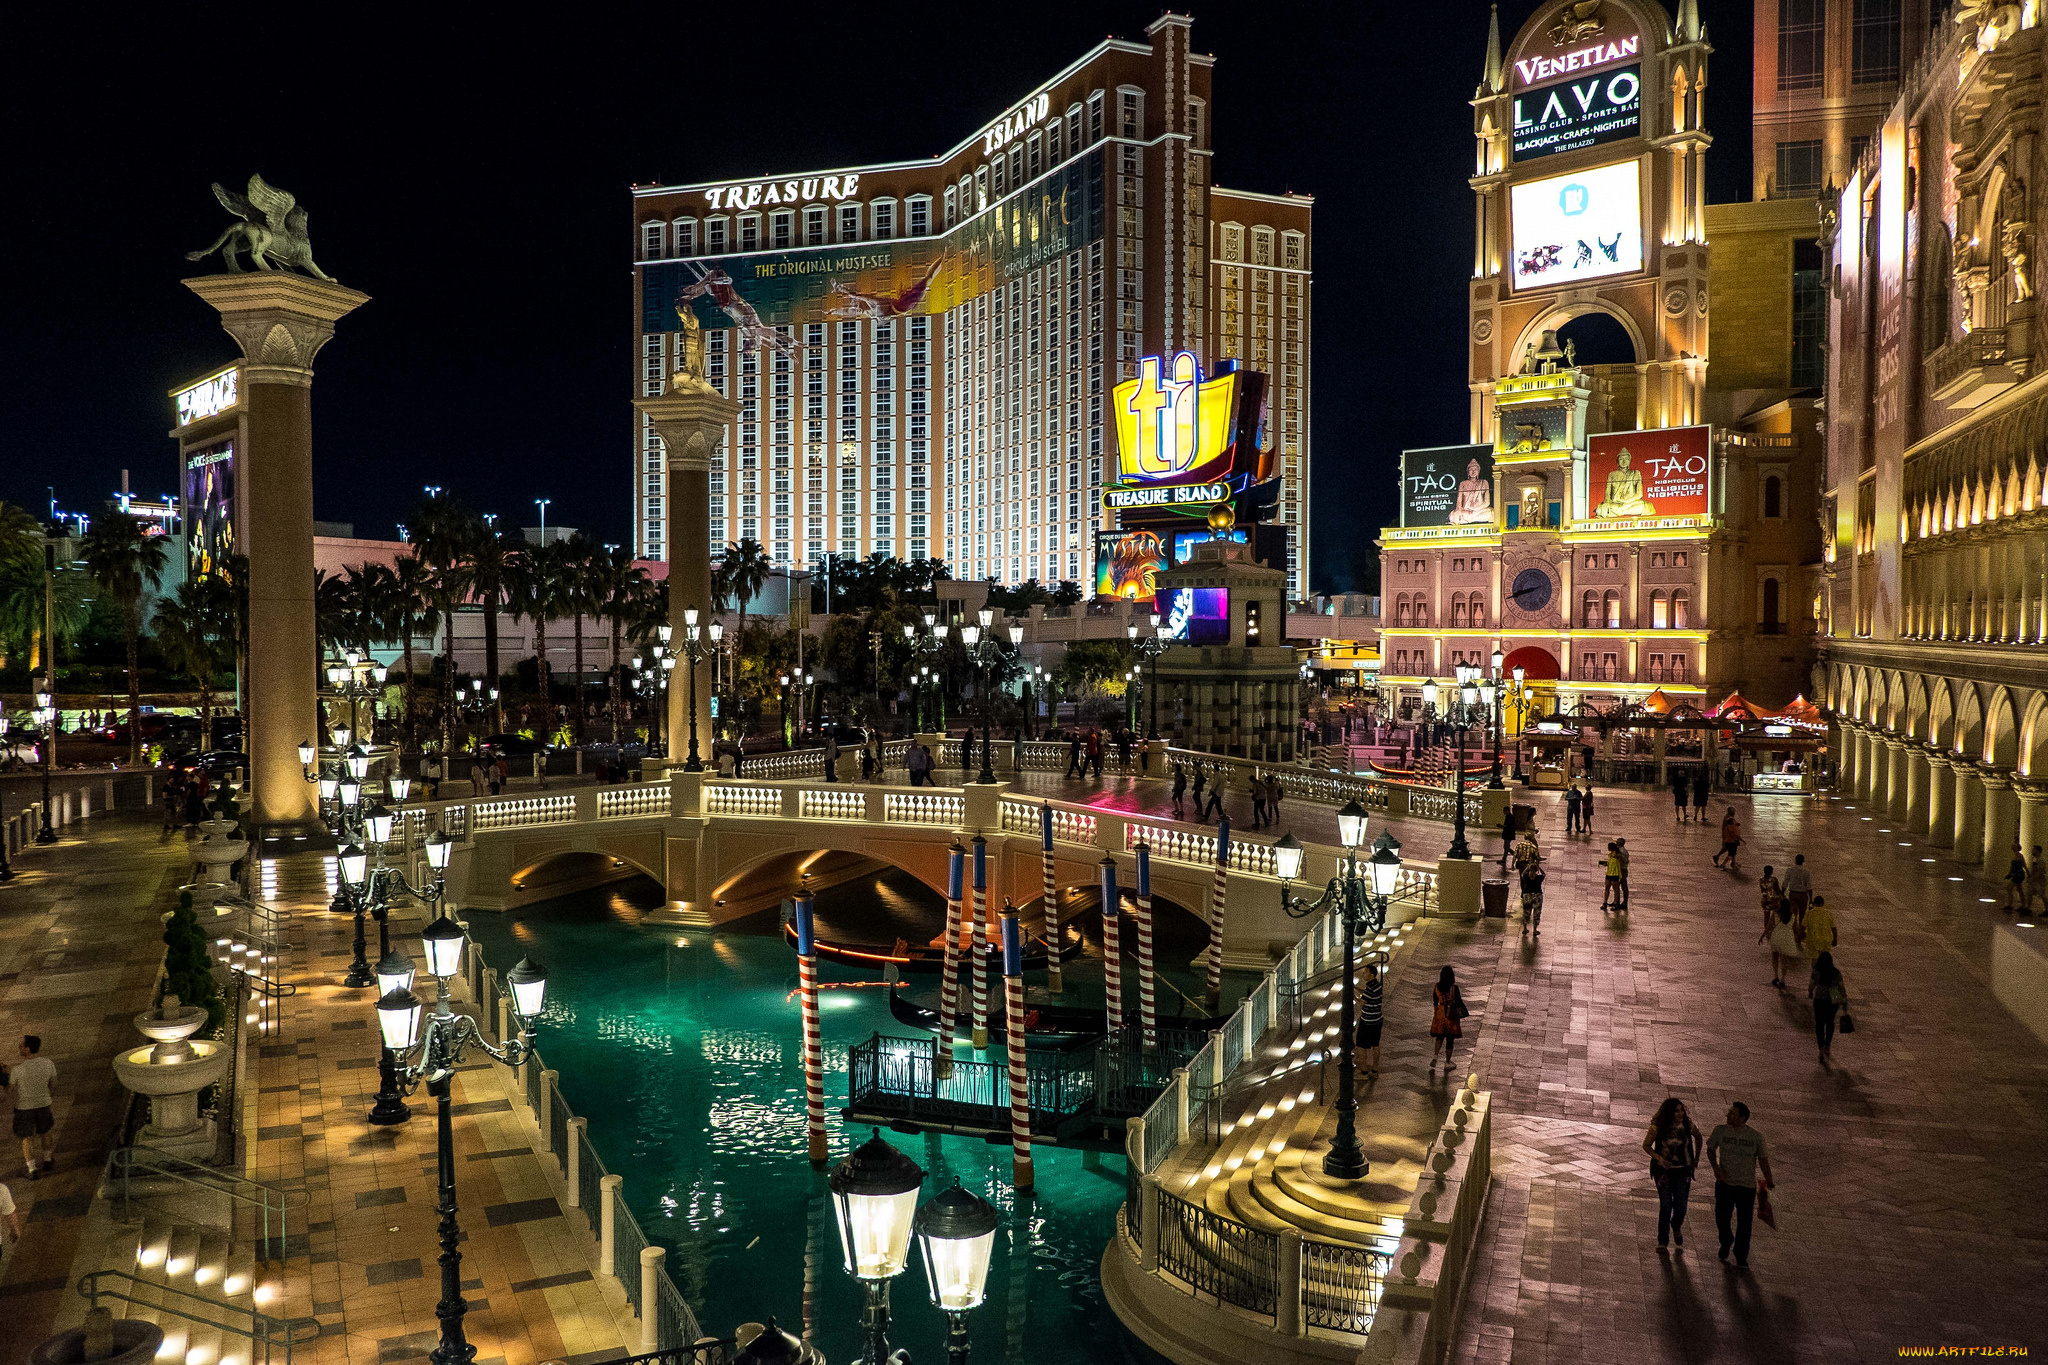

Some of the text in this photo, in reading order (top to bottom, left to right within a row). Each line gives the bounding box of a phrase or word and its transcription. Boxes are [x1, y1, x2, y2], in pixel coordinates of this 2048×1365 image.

[1515, 35, 1638, 85] VENETIAN
[1514, 72, 1640, 130] LAVO
[983, 93, 1049, 156] ISLAND
[1513, 102, 1640, 138] CASINO CLUB SPORTS BAR
[1592, 116, 1638, 134] NIGHTLIFE
[1554, 138, 1595, 153] THE PALAZZO
[705, 174, 860, 210] TREASURE
[755, 254, 891, 278] THE ORIGINAL MUST-SEE
[1880, 304, 1901, 346] CAKE
[1879, 343, 1900, 387] BOSS
[1644, 455, 1706, 478] TAO
[1407, 473, 1457, 494] TAO
[1647, 484, 1704, 493] RELIGIOUS
[1647, 490, 1703, 498] NIGHTLIFE
[1109, 485, 1222, 507] TREASURE ISLAND
